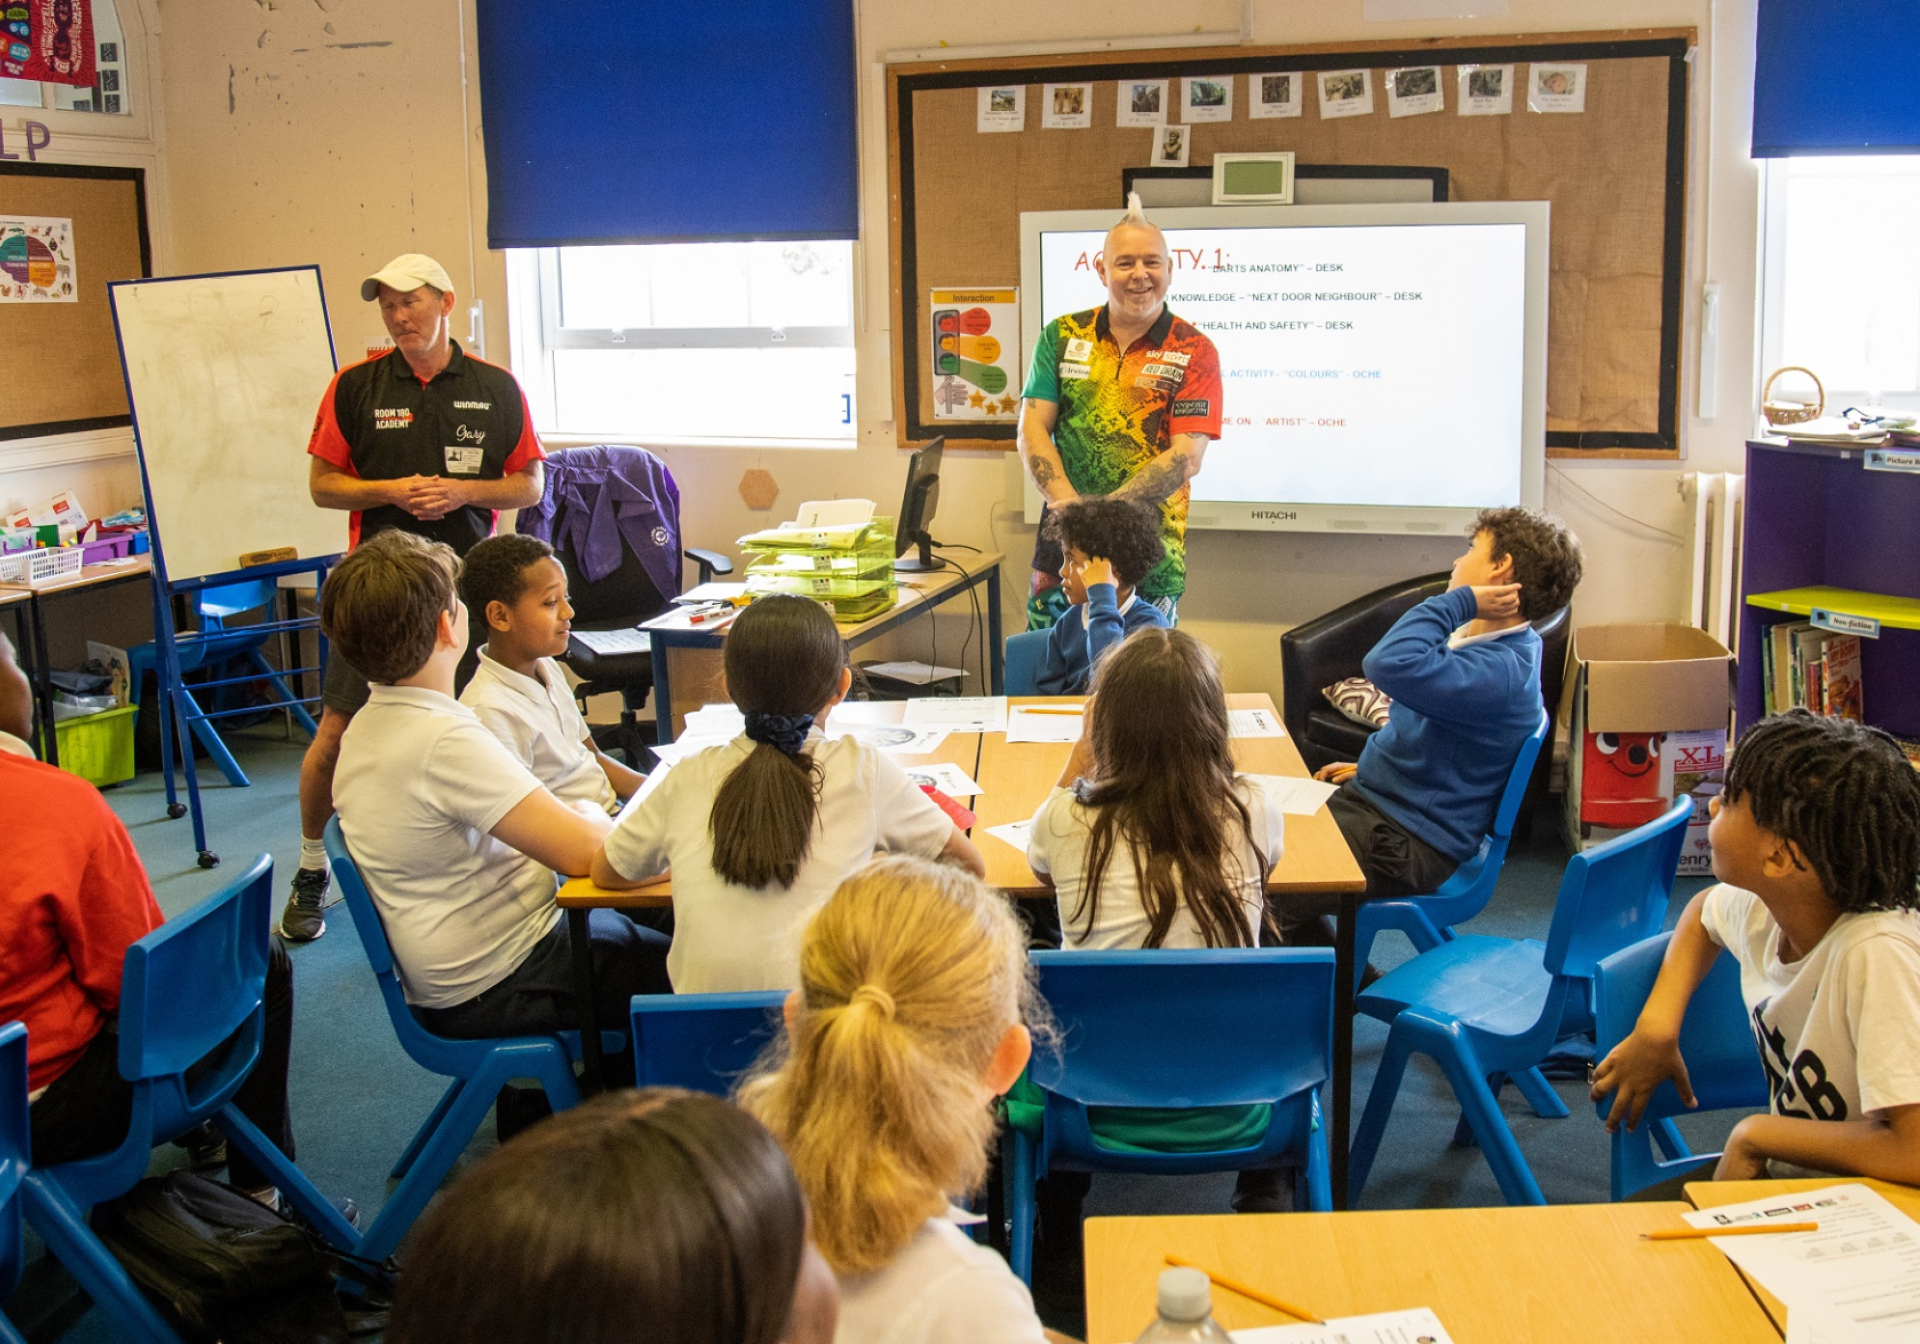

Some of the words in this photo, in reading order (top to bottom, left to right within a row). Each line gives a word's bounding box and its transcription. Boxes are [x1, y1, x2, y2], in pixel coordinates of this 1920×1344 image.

[1249, 263, 1305, 273] ANATOMY”
[1315, 263, 1343, 272] DESK
[952, 294, 995, 303] Interaction
[1171, 293, 1236, 302] KNOWLEDGE
[1281, 292, 1312, 301] DOOR
[1315, 291, 1383, 301] NEIGHBOUR”
[1394, 291, 1423, 301] DESK
[1244, 321, 1267, 330] AND
[1269, 321, 1314, 330] SAFETY”
[1325, 321, 1354, 330] DESK
[1352, 369, 1382, 379] OCHE
[374, 409, 396, 418] ROOM
[396, 408, 410, 417] 180
[376, 419, 409, 430] ACADEMY
[1236, 416, 1252, 426] ON
[1317, 418, 1347, 427] OCHE
[456, 424, 486, 444] Gary
[1886, 456, 1912, 465] Picture
[1251, 510, 1297, 520] HITACHI
[1833, 617, 1873, 630] Non-fiction
[1678, 745, 1721, 766] XL
[1679, 854, 1712, 867] enry
